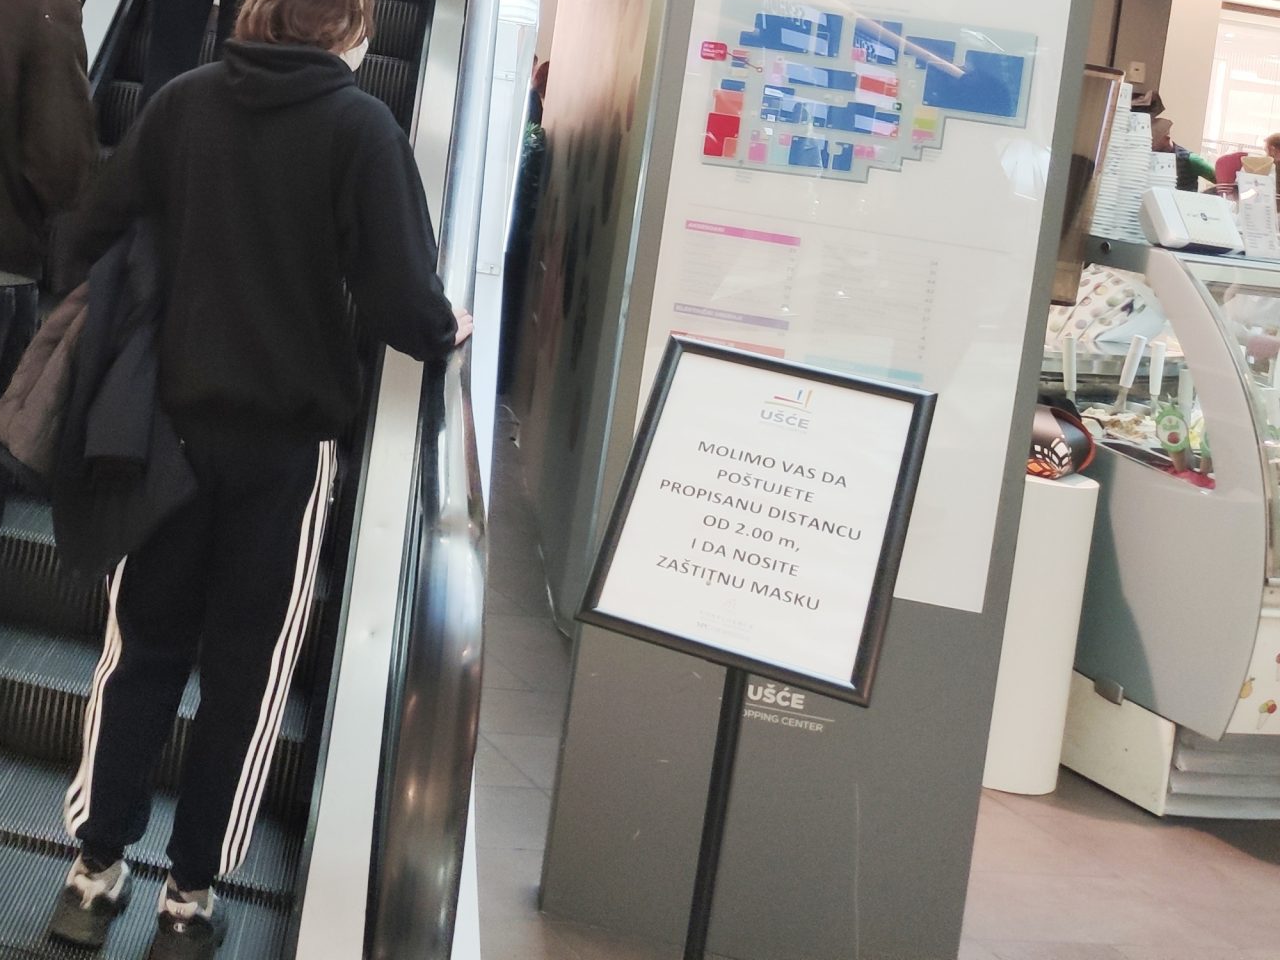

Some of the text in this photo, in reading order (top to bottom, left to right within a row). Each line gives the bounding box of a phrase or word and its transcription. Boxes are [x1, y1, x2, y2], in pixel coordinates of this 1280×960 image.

[760, 409, 810, 429] UŠĆE
[697, 441, 847, 488] MOLIMO VAS DA
[717, 469, 815, 503] POŠTUJETE
[659, 479, 862, 541] PROPISANU DISTANCU
[703, 514, 800, 553] OD 2.00 m,
[691, 538, 800, 577] I DA NOSITE
[656, 555, 820, 610] ZAŠTITNU MASKU
[747, 683, 805, 709] UŠĆE
[781, 716, 824, 732] CENTER
